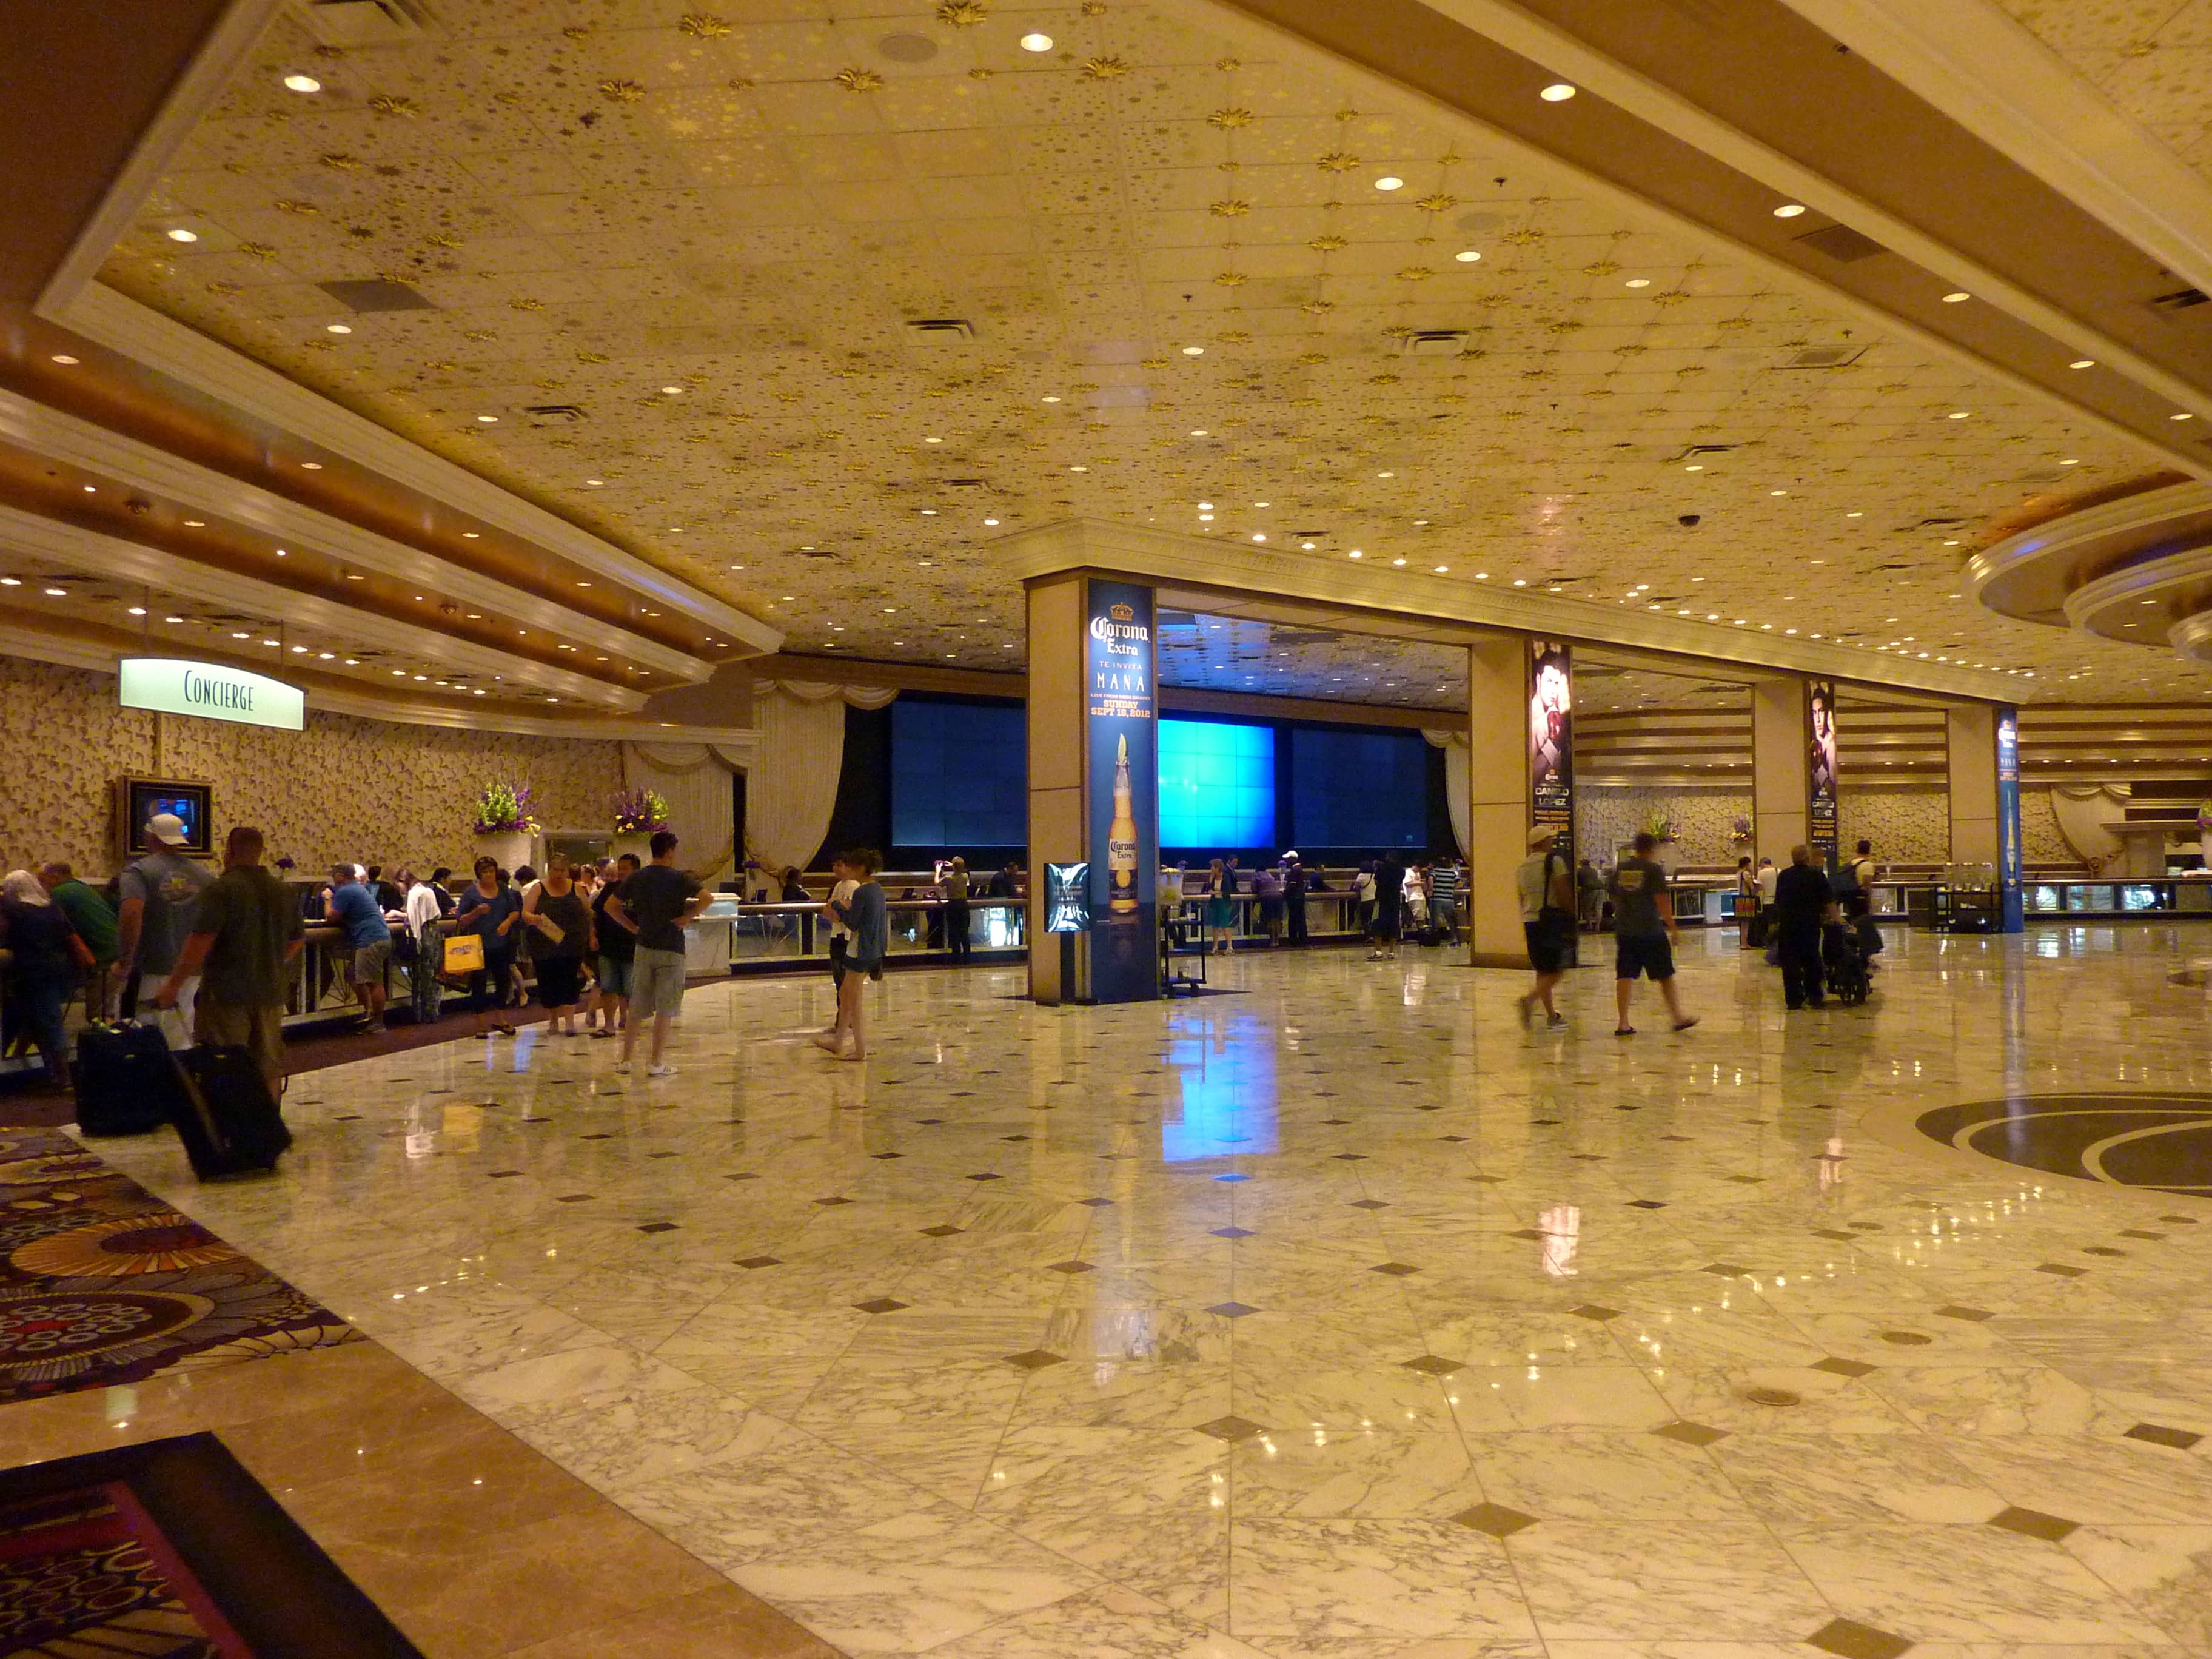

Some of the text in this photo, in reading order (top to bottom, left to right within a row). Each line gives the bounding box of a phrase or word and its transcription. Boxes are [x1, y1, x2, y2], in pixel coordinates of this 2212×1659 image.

[1090, 617, 1149, 643] Corona
[1107, 638, 1139, 656] Extra
[1113, 662, 1142, 671] INVITA
[1104, 700, 1139, 709] SUNDAY
[1091, 707, 1114, 716] SEPT
